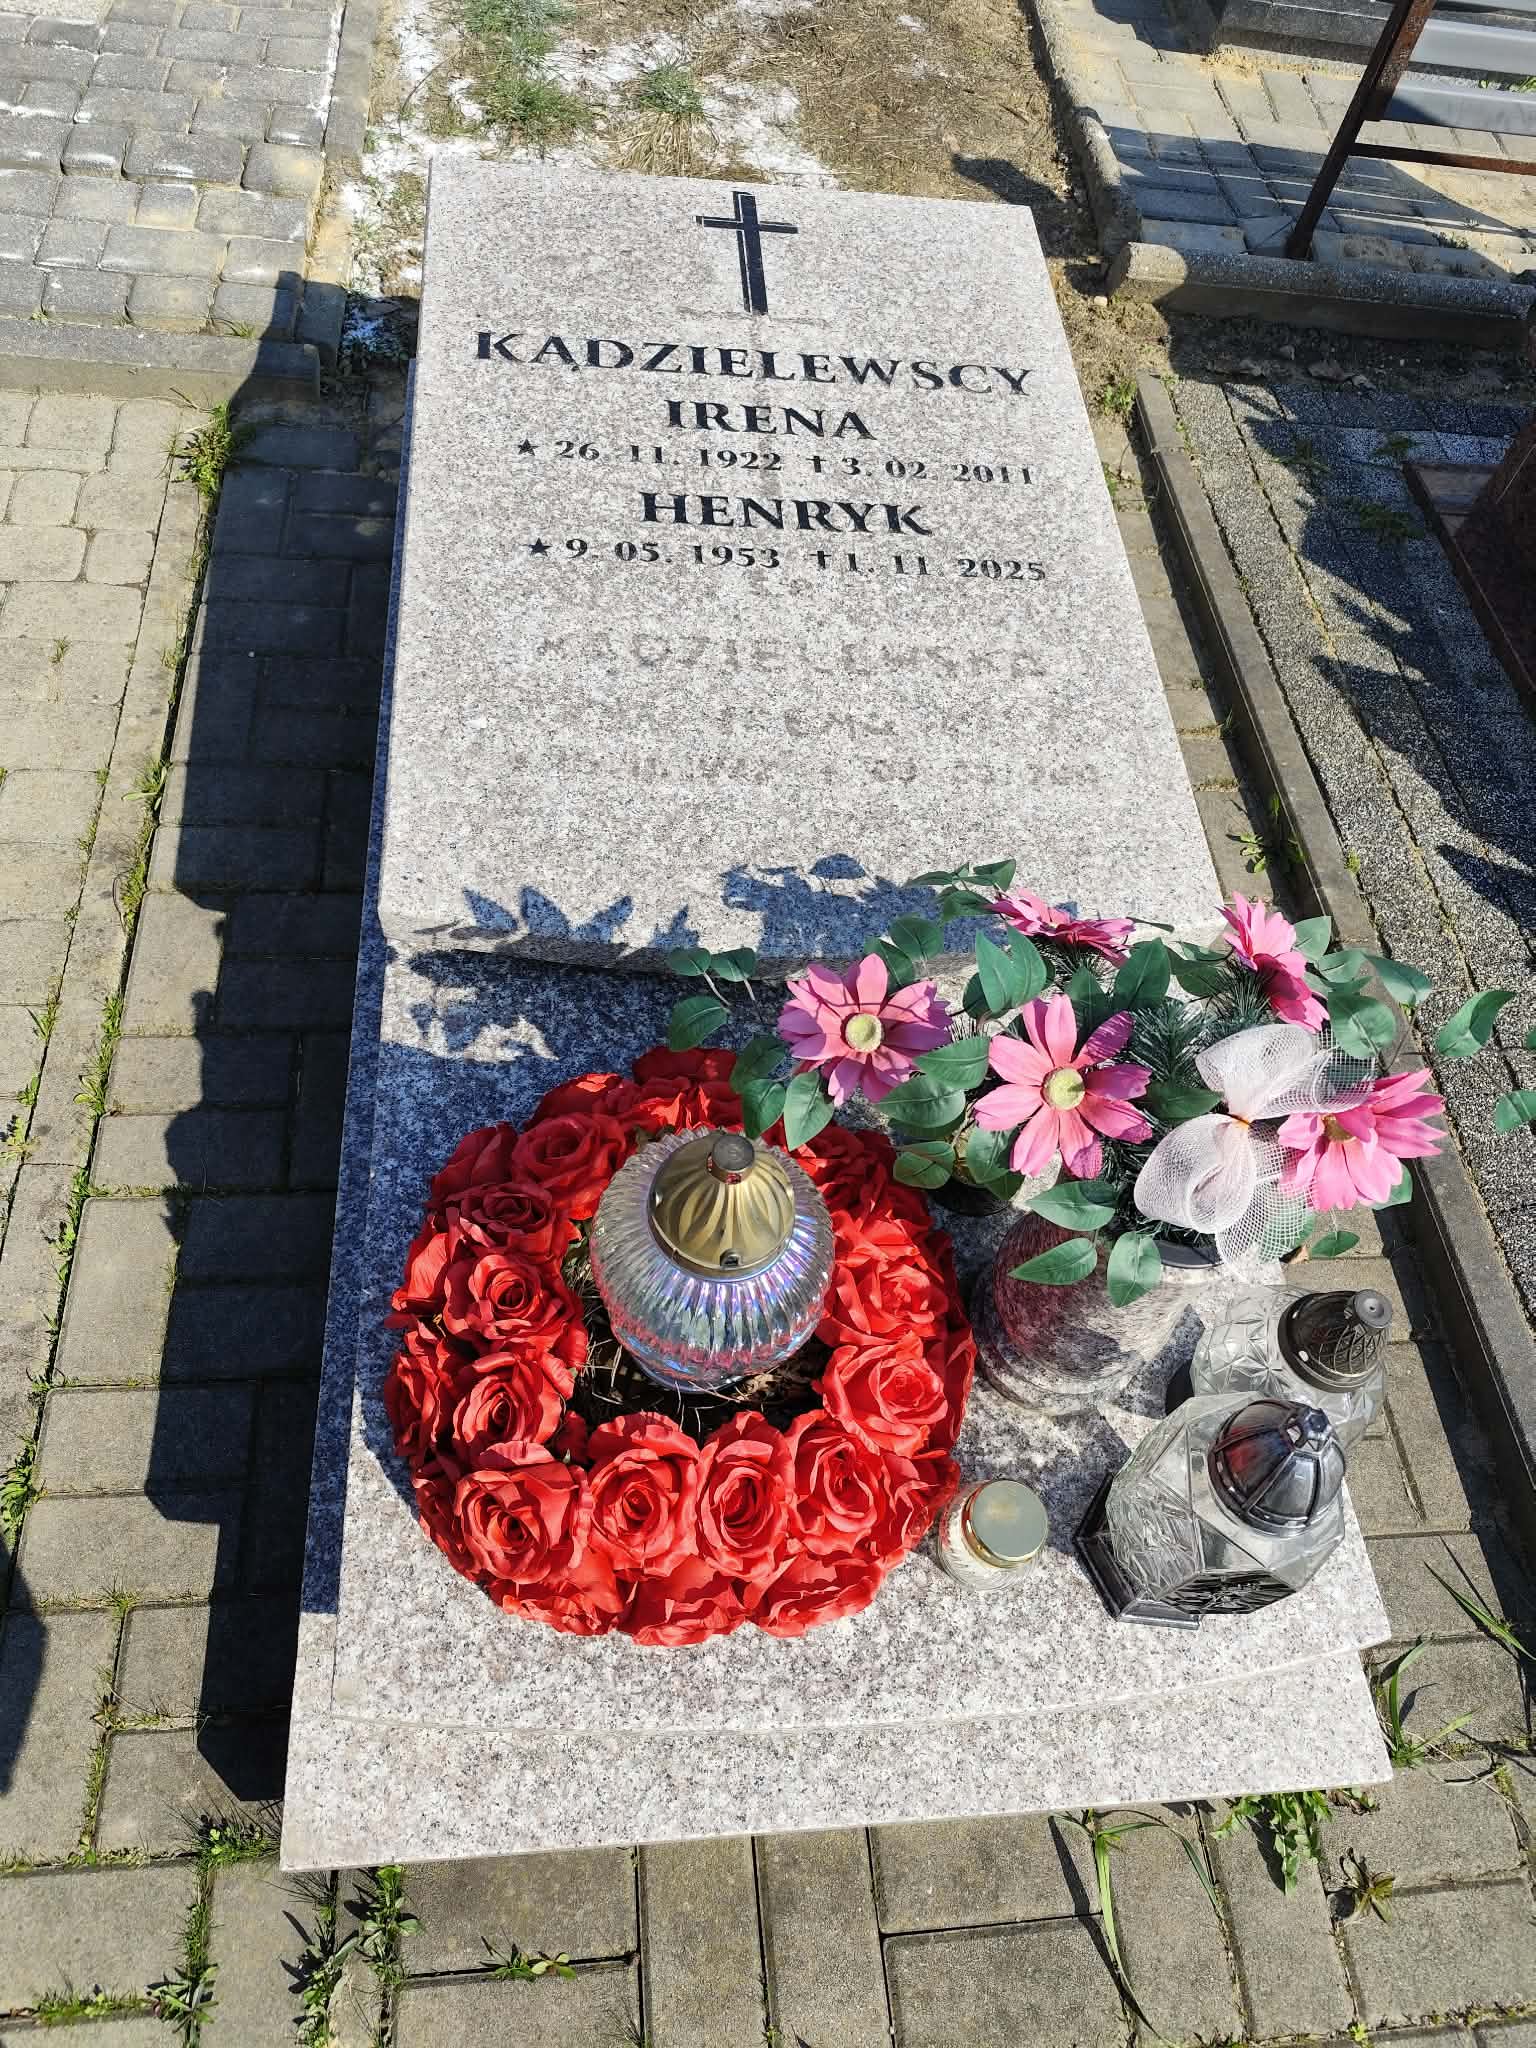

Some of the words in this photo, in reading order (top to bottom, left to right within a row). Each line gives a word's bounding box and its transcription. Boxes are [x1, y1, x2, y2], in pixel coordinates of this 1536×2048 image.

[475, 331, 1032, 396] KĄDZIELEWSCY
[664, 399, 877, 441] IRENA
[700, 449, 782, 471] 1922
[952, 463, 1032, 485] 2011
[638, 491, 932, 536] HENRYK
[694, 545, 780, 568] 1953
[957, 558, 1046, 581] 2025
